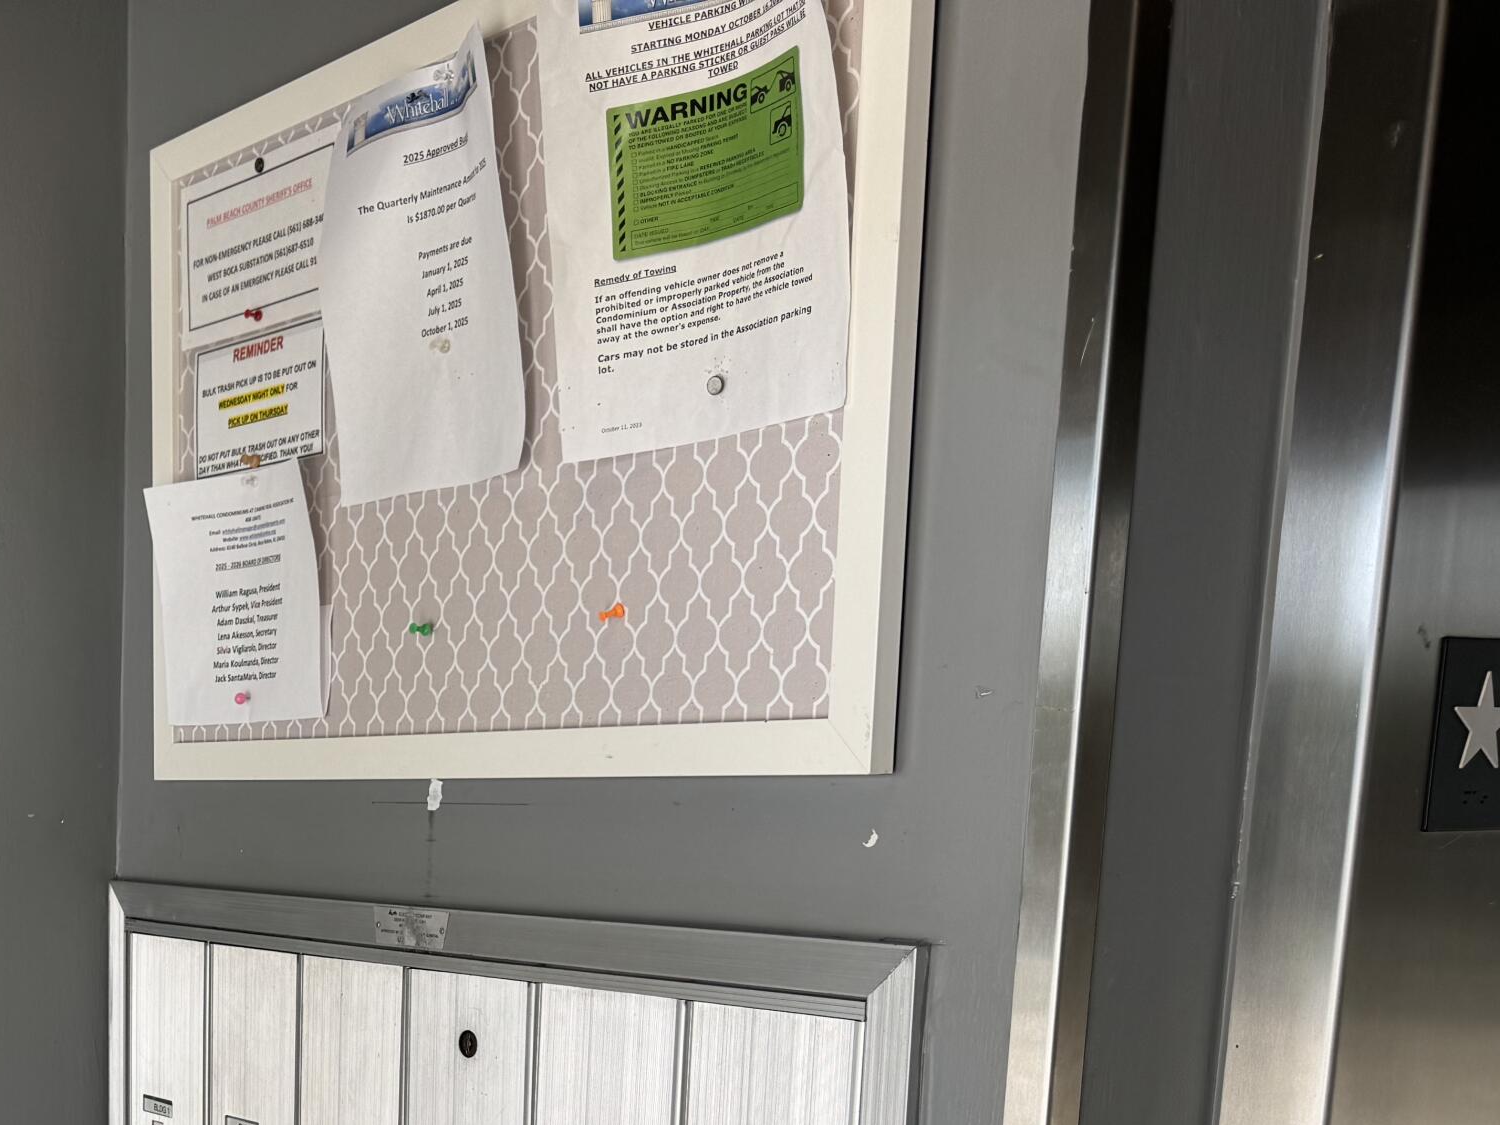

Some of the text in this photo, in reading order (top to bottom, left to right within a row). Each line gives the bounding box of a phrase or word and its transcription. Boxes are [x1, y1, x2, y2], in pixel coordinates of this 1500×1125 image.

[648, 20, 692, 31] VEHICLE
[694, 7, 737, 22] PARKING
[631, 37, 682, 53] STARTING
[685, 25, 726, 42] MONDAY
[729, 11, 761, 32] OCTOBER
[585, 72, 603, 82] ALL
[606, 61, 654, 79] VEHICLES
[657, 57, 669, 66] IN
[672, 53, 691, 64] THE
[693, 35, 744, 59] WHITEHALL
[746, 22, 773, 41] PARKING
[773, 14, 784, 26] LOT
[589, 81, 609, 91] NOT
[612, 76, 637, 87] HAVE
[651, 62, 695, 80] PARKING
[699, 53, 736, 69] STICKER
[738, 45, 748, 56] OR
[750, 32, 769, 50] GUEST
[708, 61, 738, 77] TOWED
[387, 91, 449, 124] Whitehall
[626, 83, 748, 129] WARNING
[403, 140, 458, 164] 2025 Approved
[358, 179, 461, 215] The Quarterly Maintenance
[407, 202, 456, 223] Is $1870.00 per
[194, 257, 204, 269] FOR
[204, 241, 251, 264] NON-EMERGENCY
[252, 234, 272, 250] PLEASE
[273, 229, 286, 241] CALL
[418, 236, 472, 260] Payments are due
[207, 269, 222, 282] WEST
[223, 264, 238, 278] BOCA
[239, 249, 273, 271] SUBSTATION
[422, 265, 447, 279] January
[453, 256, 468, 269] 2025
[594, 264, 676, 287] Remedy of Towing
[427, 286, 441, 298] April
[449, 278, 464, 289] 2025
[428, 304, 440, 317] July
[448, 298, 462, 310] 2025
[421, 325, 446, 337] October
[454, 317, 468, 328] 2025
[598, 305, 812, 362] Cars may not be stored in the Association parking
[233, 336, 283, 362] REMINDER
[202, 385, 217, 398] BULK
[217, 381, 235, 393] TRASH
[235, 377, 248, 388] PICK
[249, 375, 256, 385] UP
[264, 373, 272, 381] TO
[282, 368, 292, 377] PUT
[294, 364, 306, 374] OUT
[307, 360, 316, 369] ON
[598, 365, 614, 374] lot.
[252, 389, 269, 402] NIGHT
[270, 385, 285, 397] ONLY
[286, 382, 298, 393] FOR
[228, 417, 240, 427] PICK
[250, 412, 259, 422] ON
[259, 405, 288, 420] THURSDAY
[259, 583, 280, 593] President
[212, 603, 230, 613] Arthur
[261, 597, 282, 607] President
